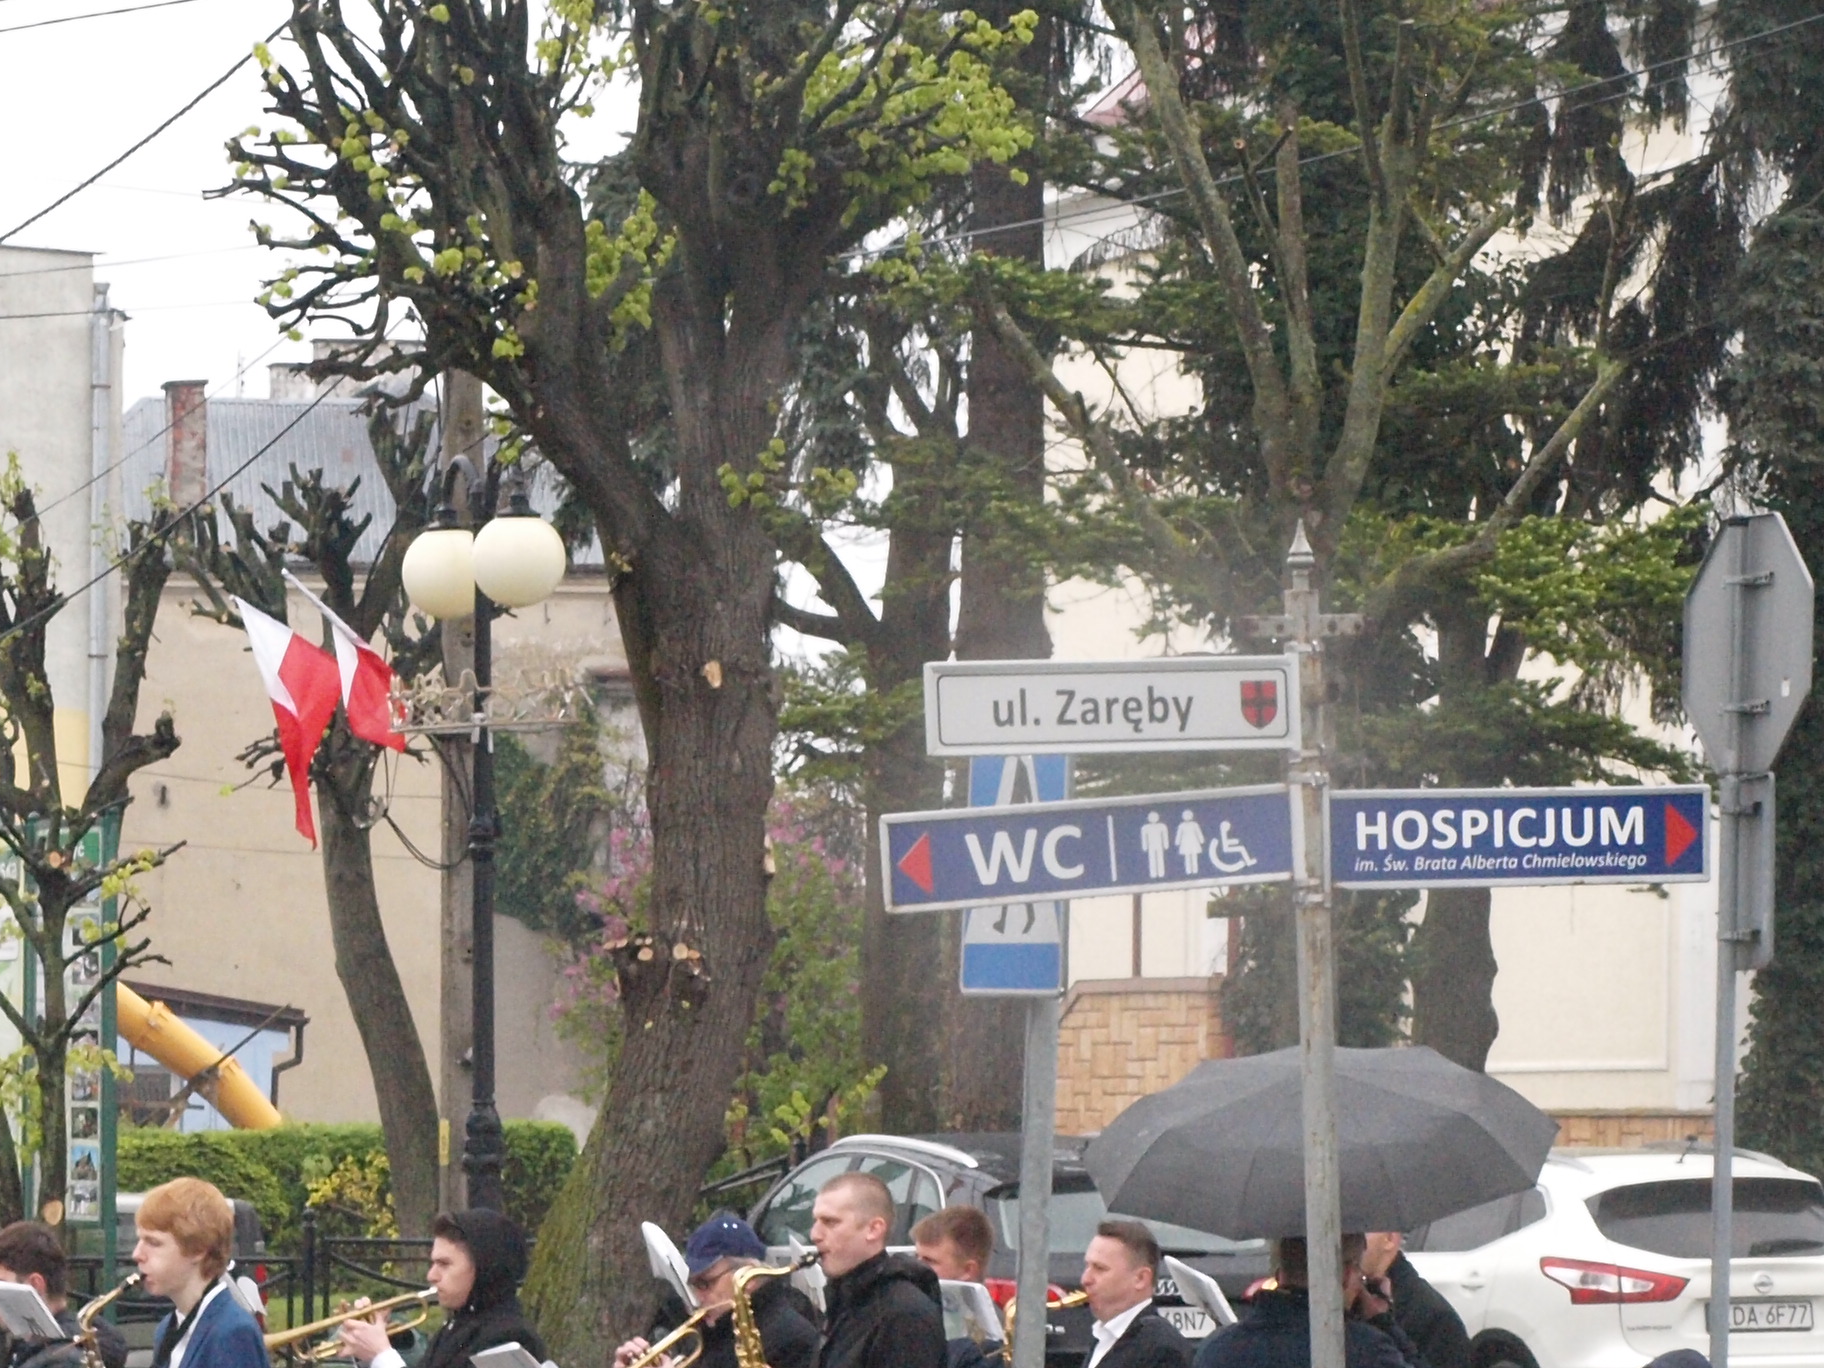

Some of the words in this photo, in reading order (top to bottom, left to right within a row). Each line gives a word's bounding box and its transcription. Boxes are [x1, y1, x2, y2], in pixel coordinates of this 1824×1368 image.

[993, 687, 1041, 728] ul.
[1055, 685, 1195, 734] Zaręby
[1354, 805, 1646, 850] HOSPICJUM
[964, 824, 1086, 886] WC
[1354, 857, 1379, 872] im.
[1383, 854, 1409, 872] Św.
[1414, 855, 1457, 871] Brata
[1461, 853, 1518, 870] Alberta
[1522, 851, 1648, 870] Chmielowskiego
[1165, 1310, 1207, 1332] 8N7
[1732, 1305, 1759, 1327] DA
[1765, 1304, 1808, 1326] 6F77
